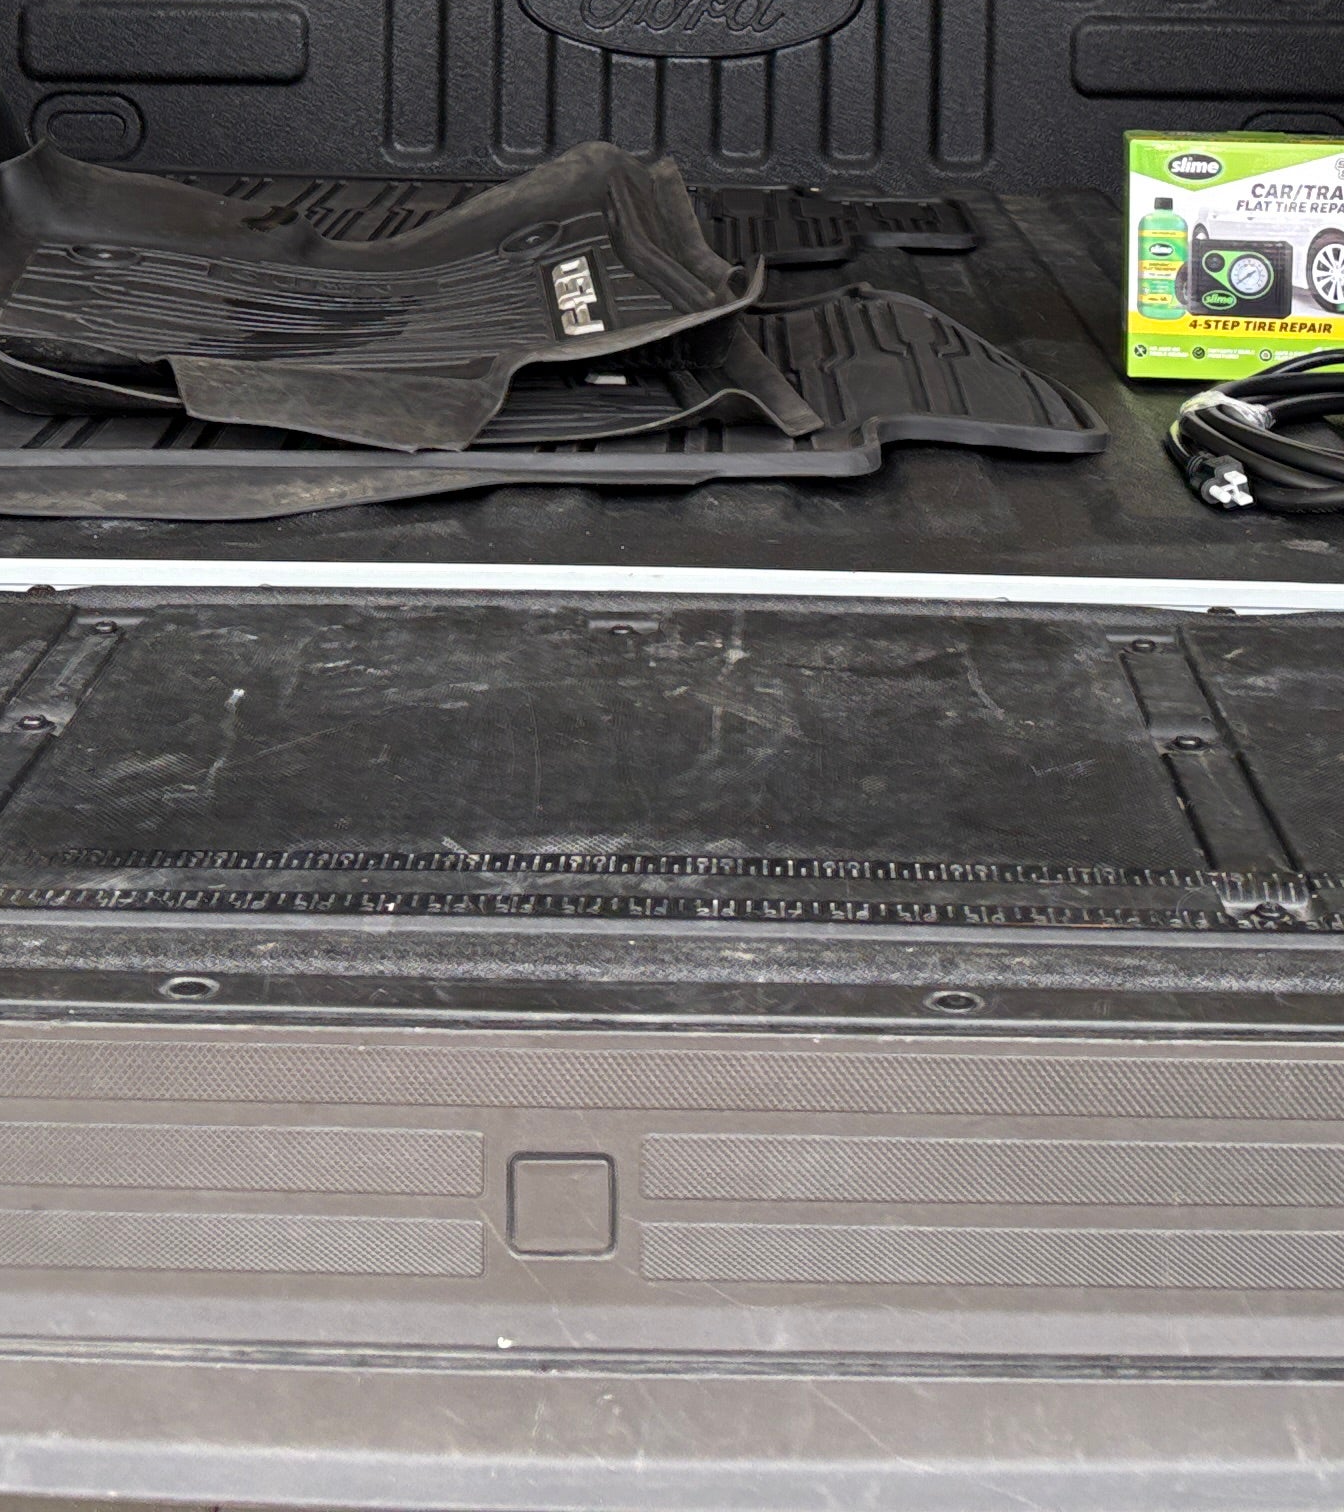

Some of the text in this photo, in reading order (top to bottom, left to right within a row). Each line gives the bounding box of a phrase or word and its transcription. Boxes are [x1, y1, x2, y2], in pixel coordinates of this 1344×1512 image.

[1171, 156, 1219, 175] slime
[1236, 200, 1272, 212] FLAT
[1275, 201, 1307, 213] TIRE
[1188, 319, 1333, 335] 4-STEP TIRE REPAIR
